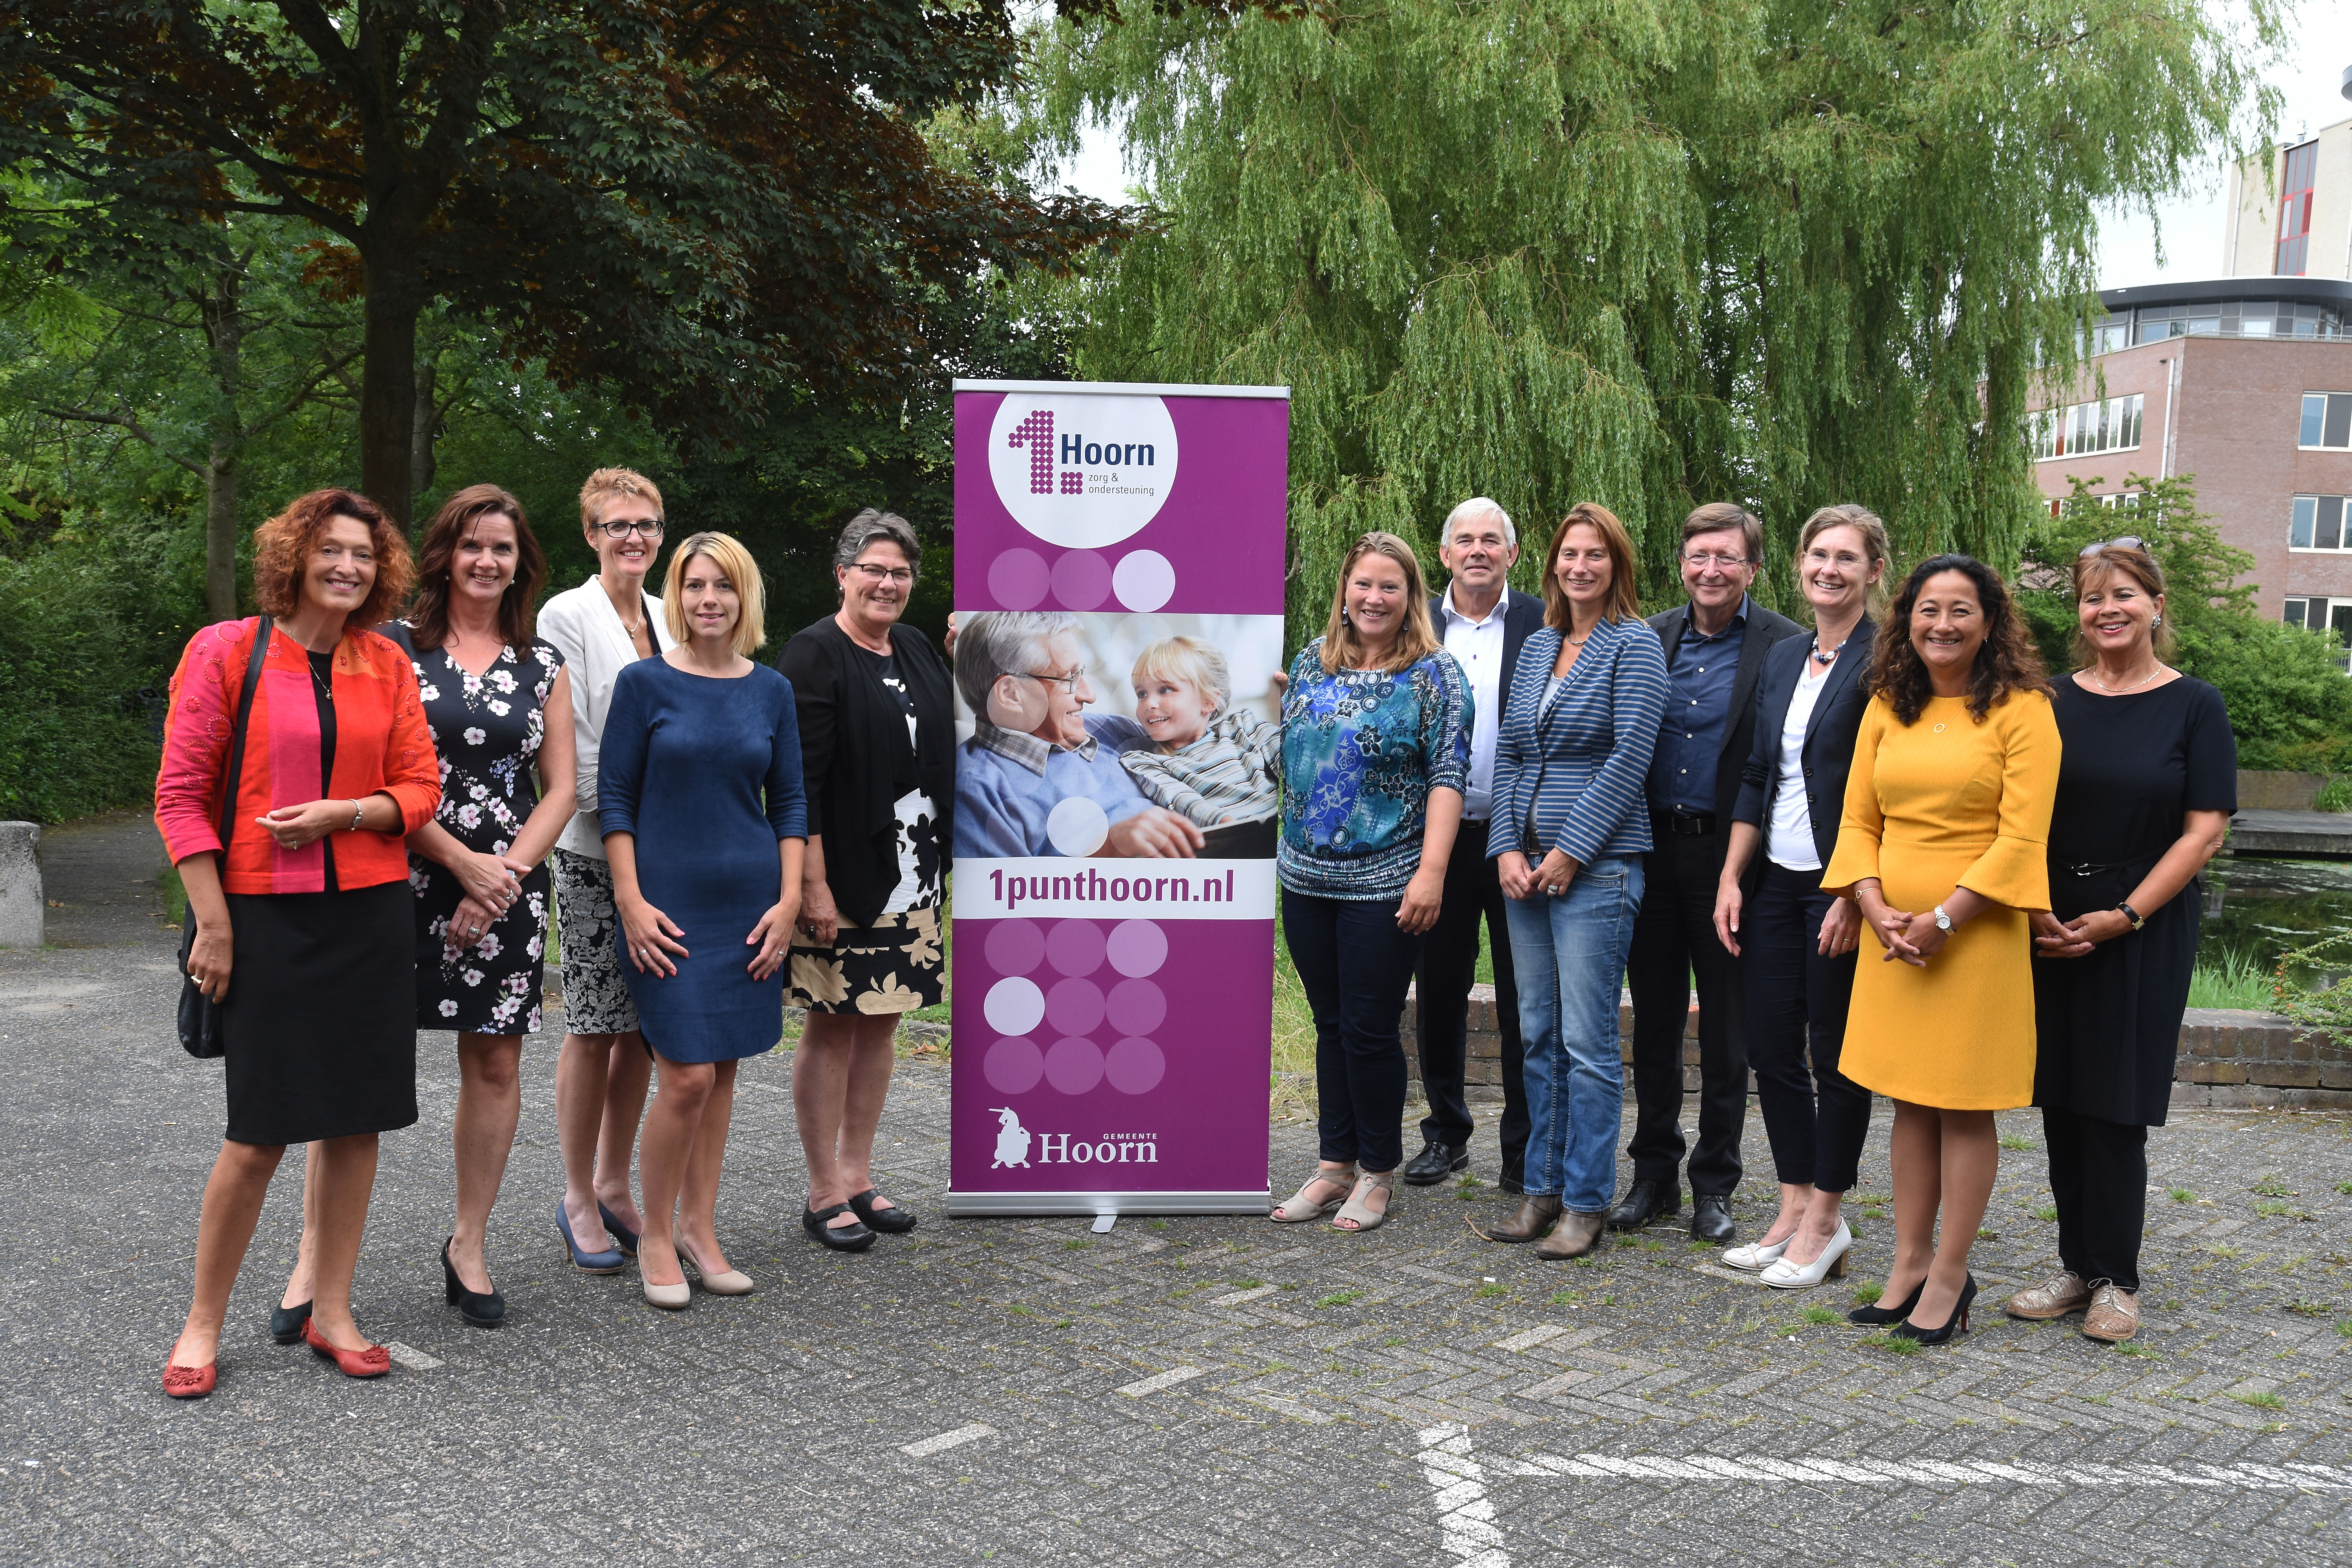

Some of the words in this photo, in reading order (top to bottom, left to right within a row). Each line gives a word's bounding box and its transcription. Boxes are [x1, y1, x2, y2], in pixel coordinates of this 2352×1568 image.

[1061, 434, 1154, 466] Hoorn
[1089, 475, 1108, 484] zorg
[1111, 473, 1118, 482] &
[1089, 485, 1154, 496] ondersteuning
[989, 868, 1234, 910] 1punthoorn.nl
[1038, 1134, 1158, 1163] Hoorn
